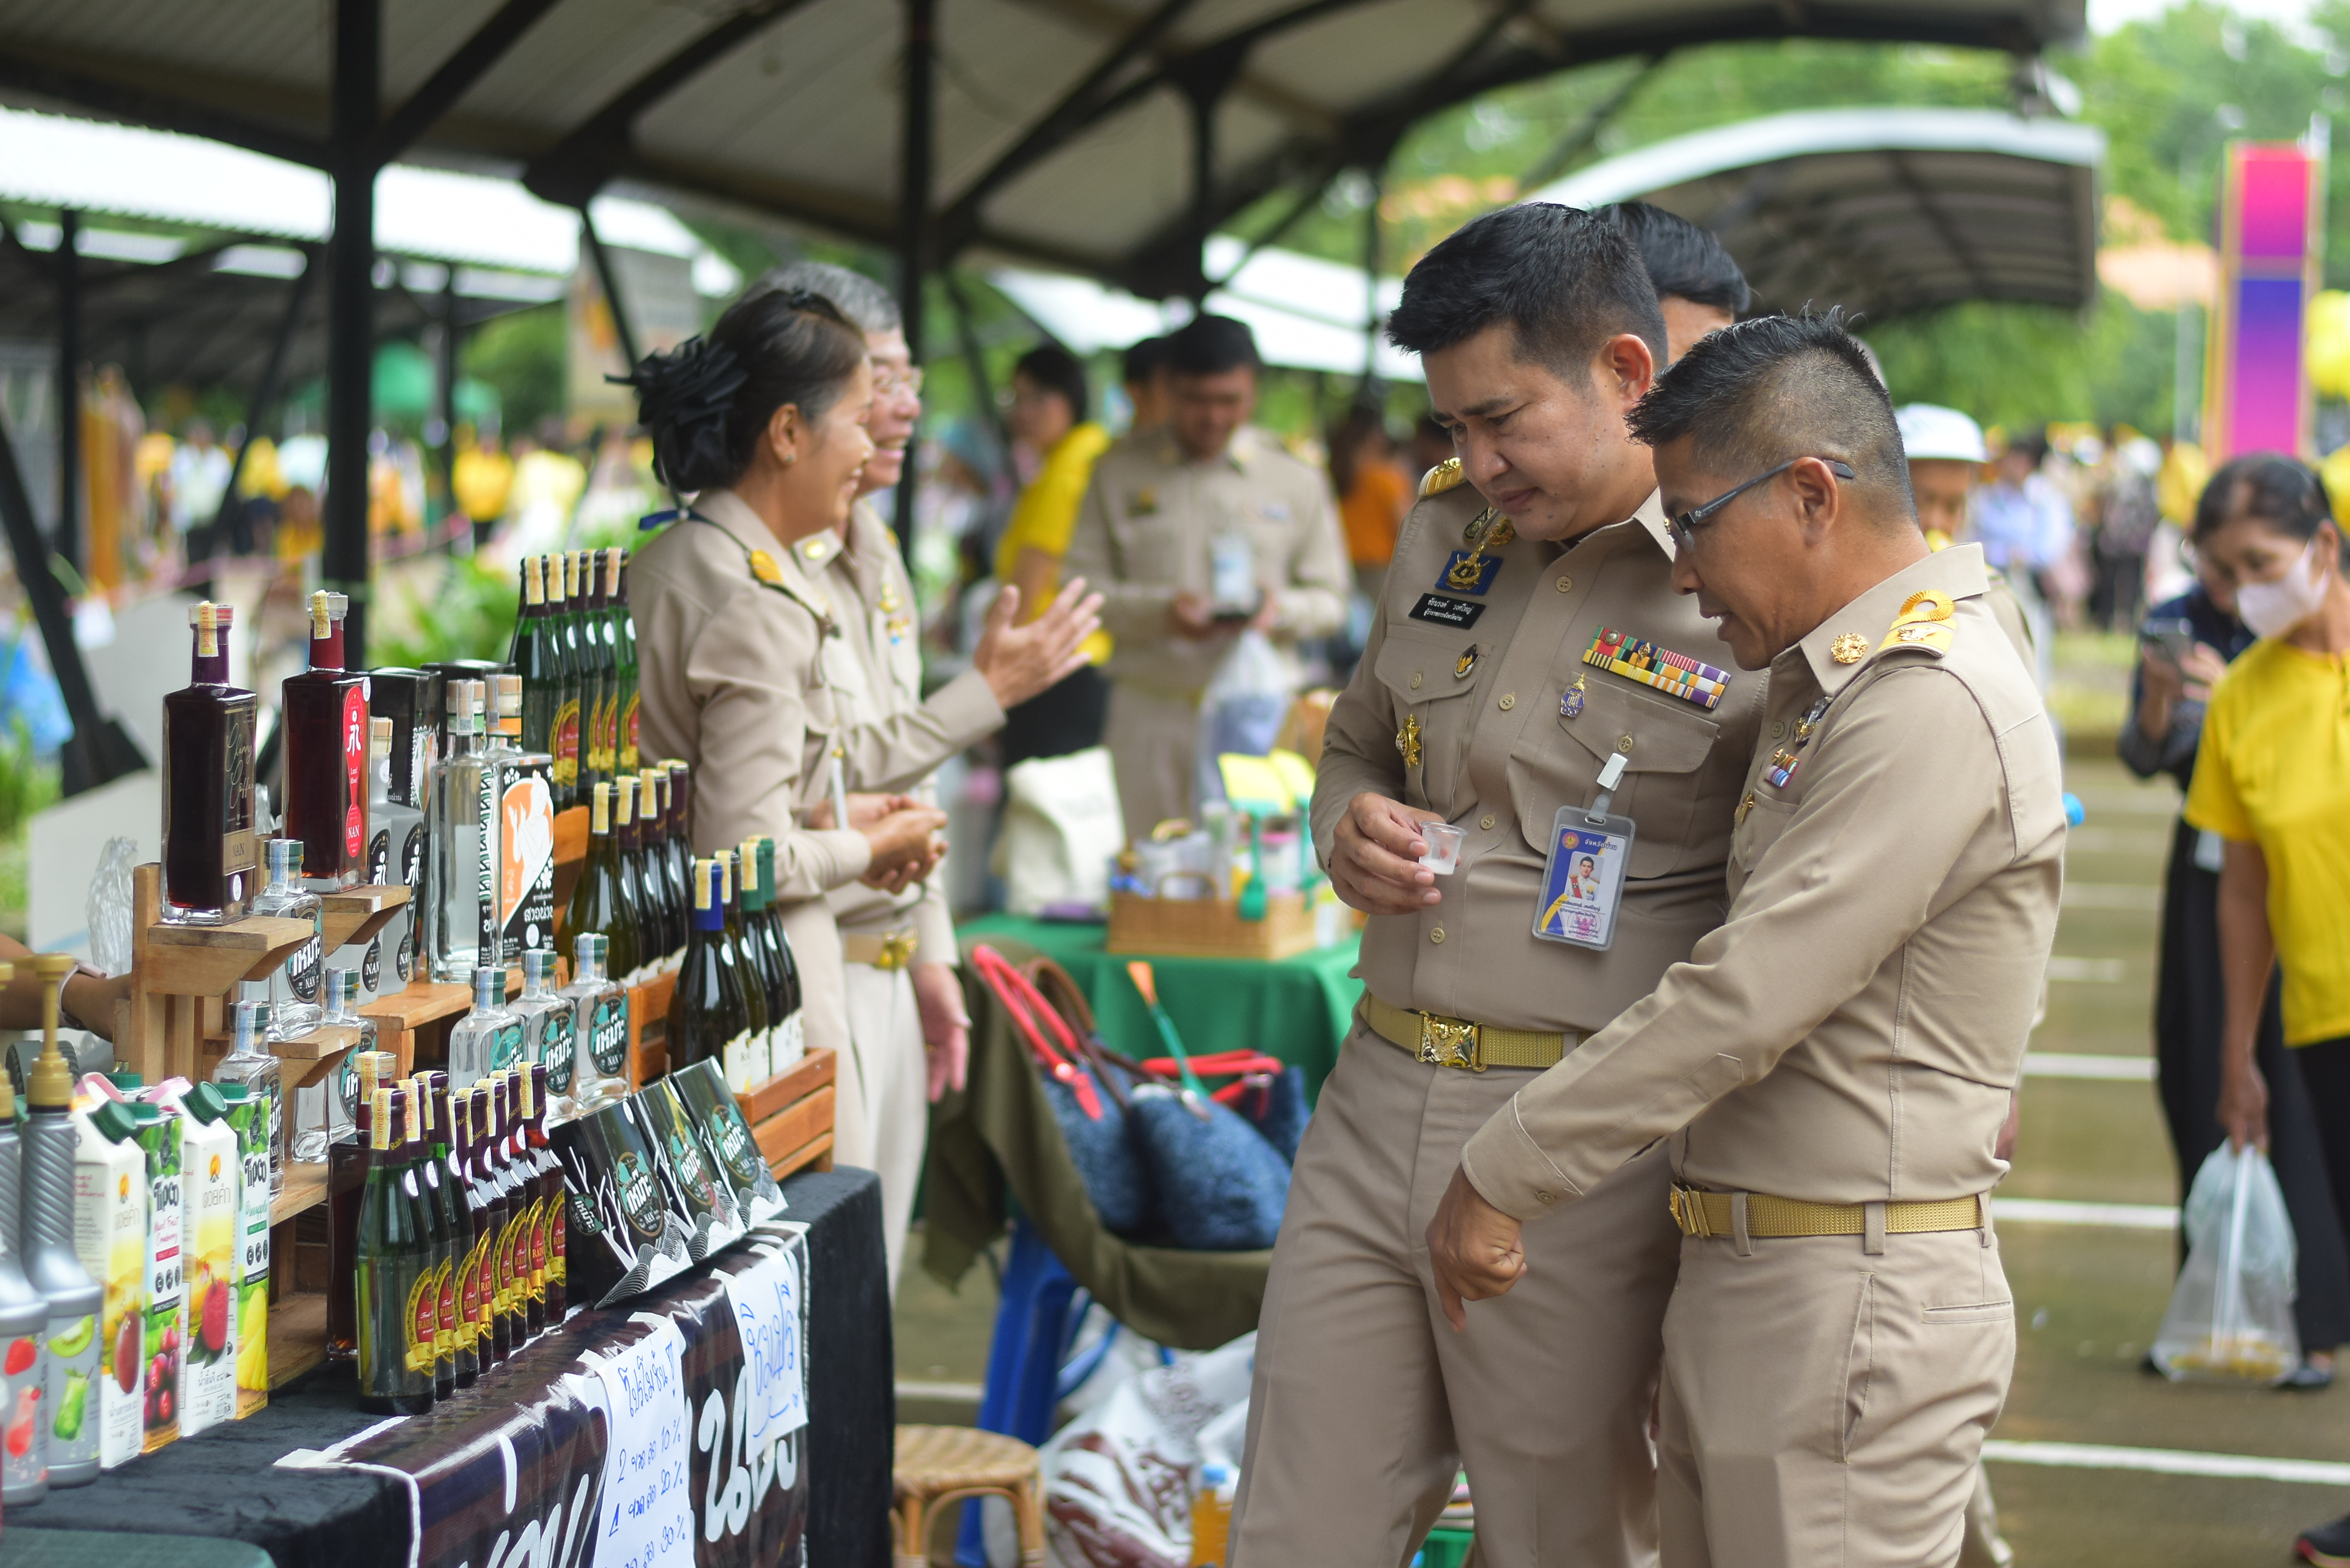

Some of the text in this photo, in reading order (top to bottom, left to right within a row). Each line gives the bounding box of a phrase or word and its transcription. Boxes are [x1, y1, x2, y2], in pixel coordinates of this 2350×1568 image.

[348, 824, 360, 839] NAN
[233, 843, 245, 857] NAN
[1585, 838, 1617, 851] จังหวัดน่าน
[305, 975, 315, 988] NAN
[608, 1055, 618, 1066] NAN
[557, 1073, 566, 1085] NAN
[203, 1183, 231, 1208] ดอยคำ
[644, 1211, 655, 1224] NAN
[740, 1280, 793, 1396] ชิมฟรี
[617, 1448, 626, 1483] 2
